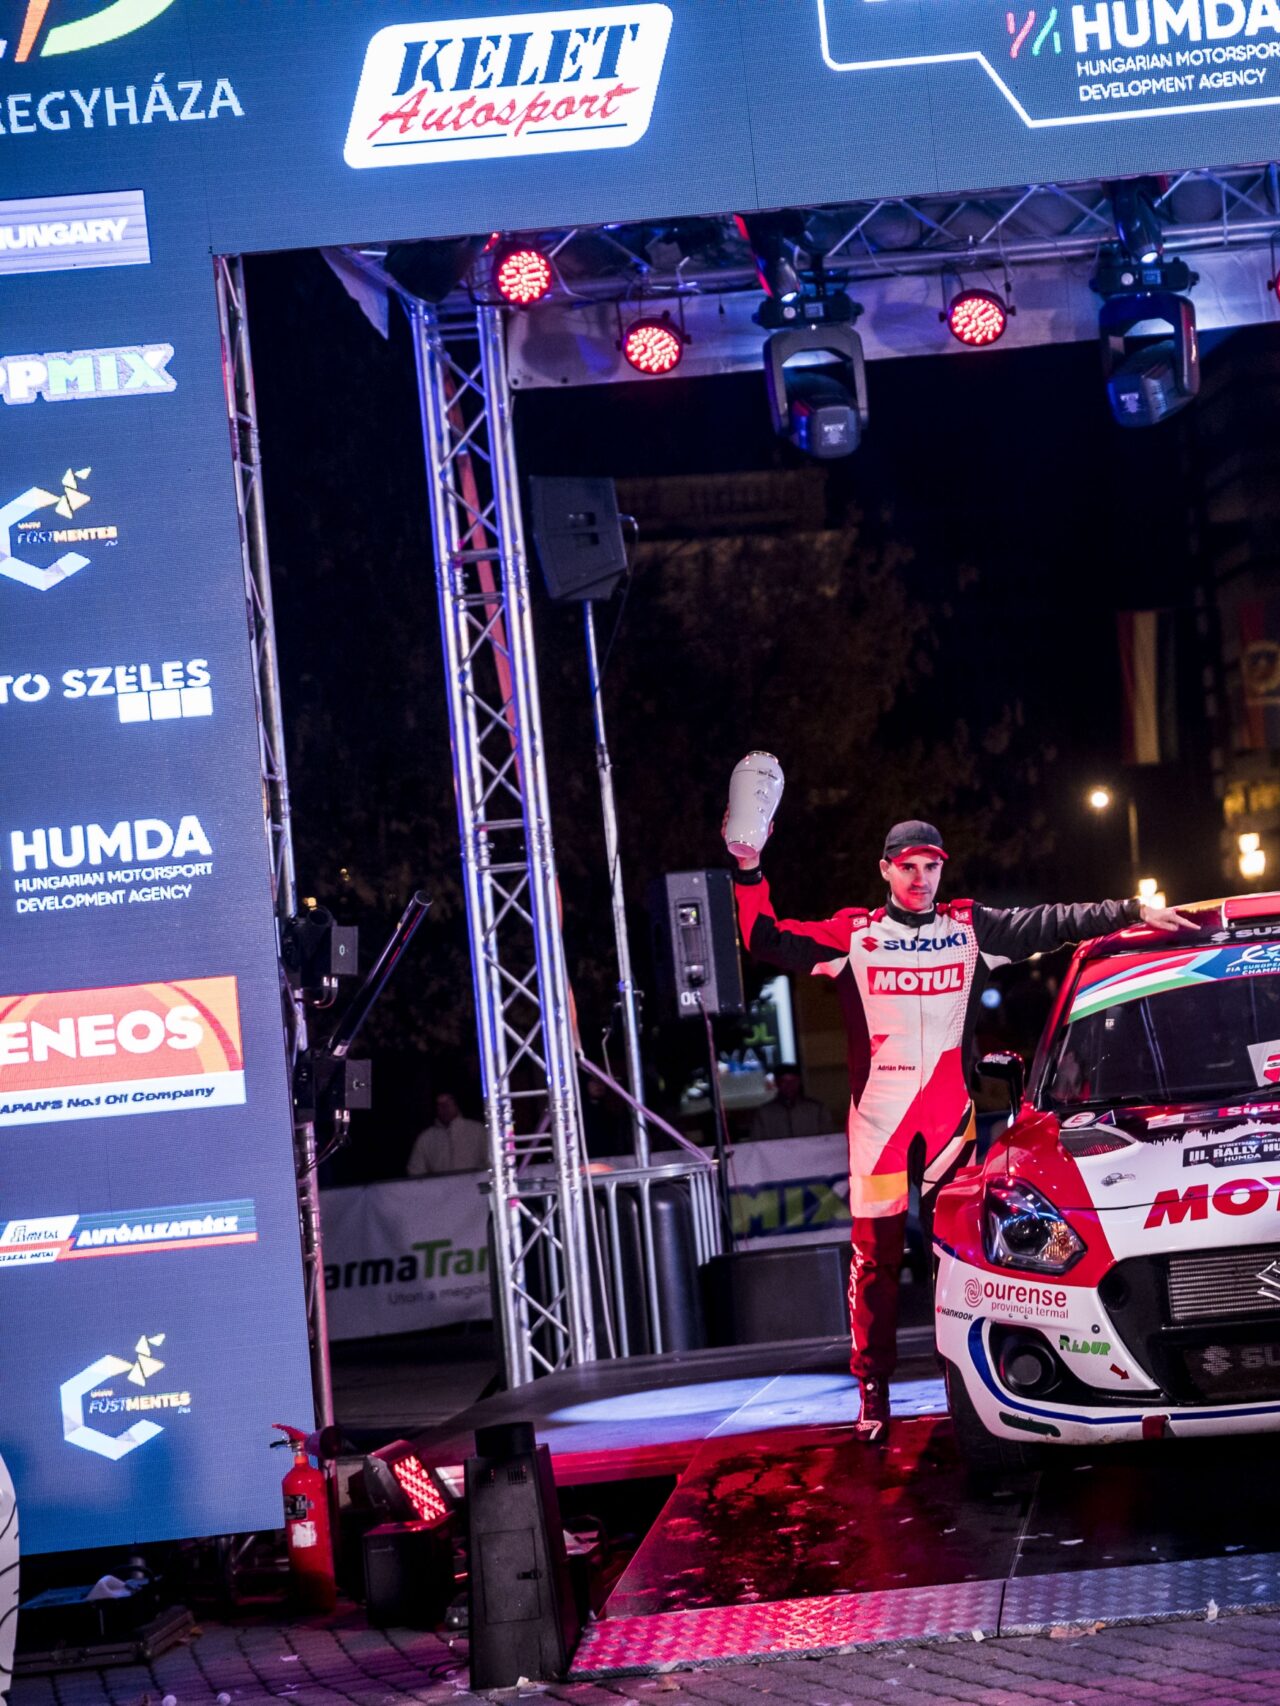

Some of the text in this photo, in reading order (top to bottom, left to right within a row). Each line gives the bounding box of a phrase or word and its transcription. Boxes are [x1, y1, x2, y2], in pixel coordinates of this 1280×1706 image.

[392, 23, 640, 96] KELET
[1076, 52, 1173, 77] HUNGARIAN
[1078, 67, 1267, 102] DEVELOPMENT AGENCY
[367, 82, 641, 141] Autosport
[11, 815, 213, 872] HUMDA
[15, 862, 213, 893] HUNGARIAN MOTORSPORT
[16, 884, 192, 913] DEVELOPMENT AGENCY
[883, 932, 968, 953] SUZUKI
[873, 967, 962, 992] MOTUL
[0, 1005, 205, 1066] ENEOS
[131, 1086, 215, 1102] Company
[1213, 1145, 1260, 1159] RALLY
[1223, 1152, 1262, 1163] HUMDA
[983, 1281, 1068, 1308] ourense
[991, 1301, 1069, 1320] provincia termal
